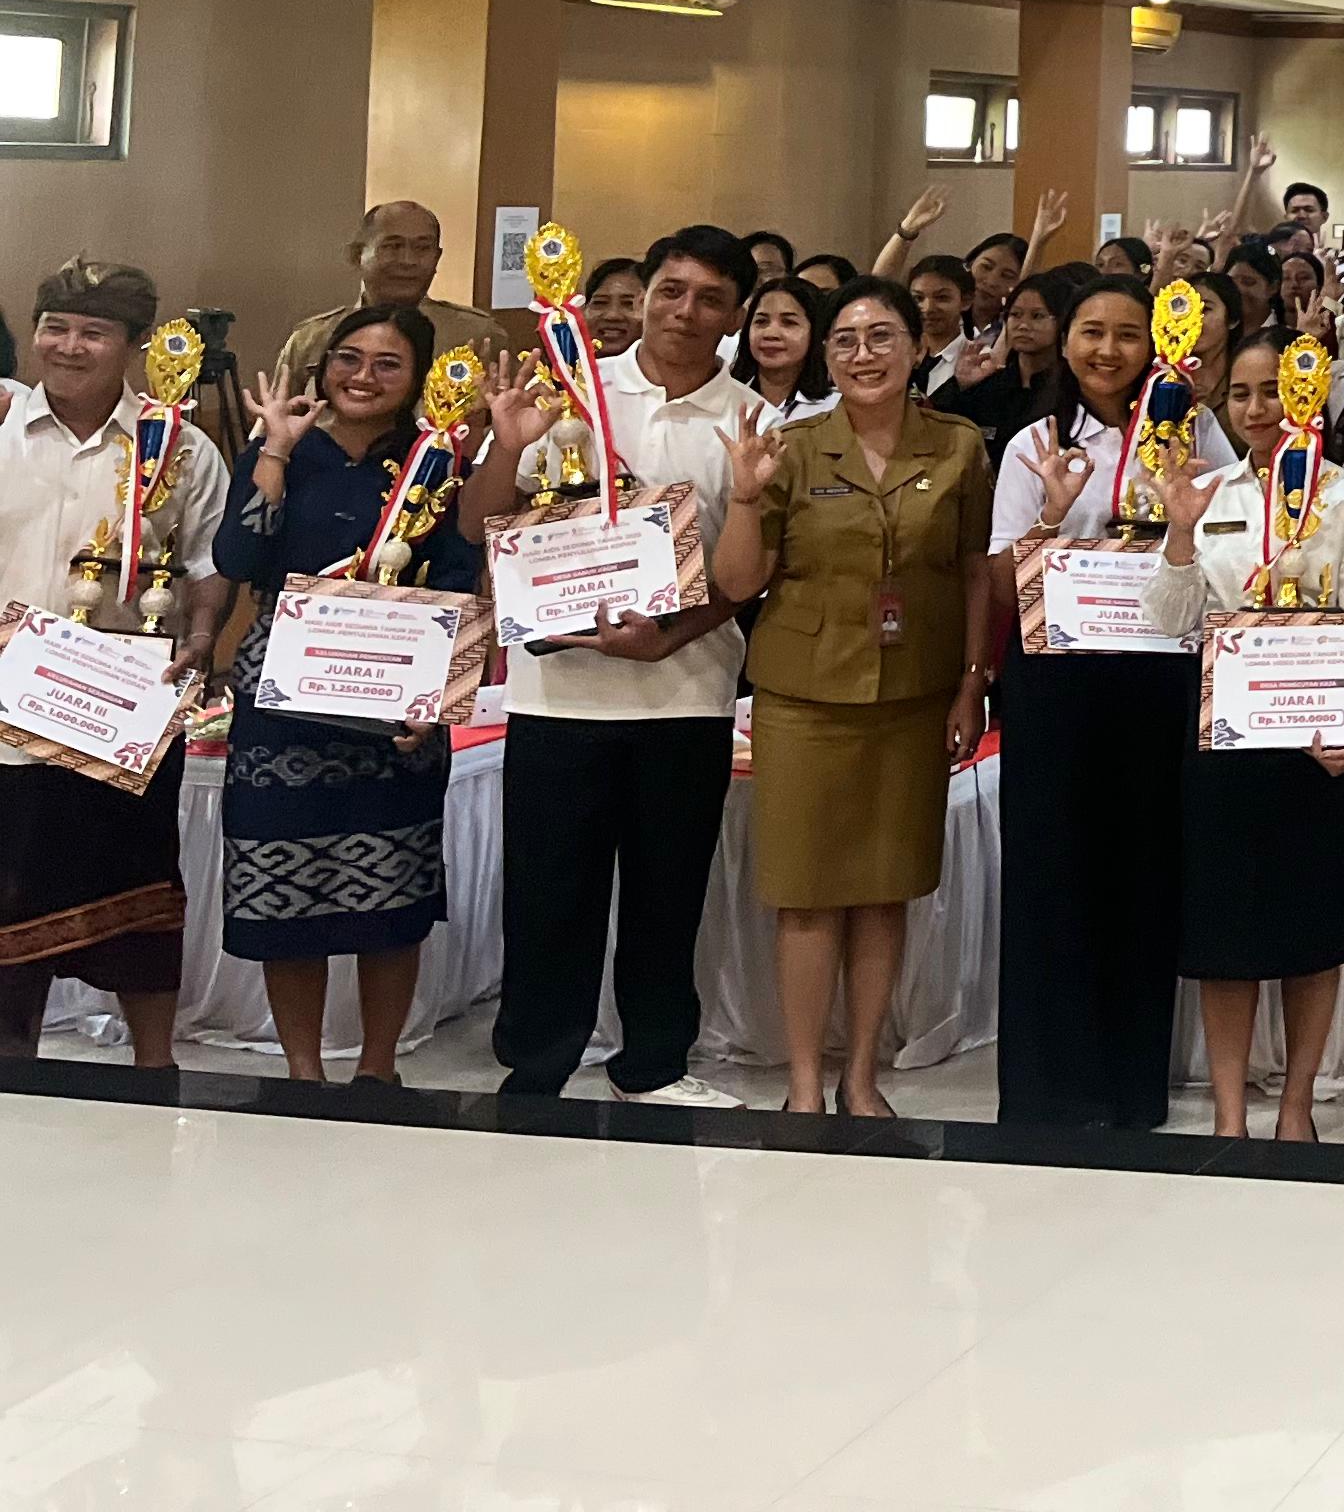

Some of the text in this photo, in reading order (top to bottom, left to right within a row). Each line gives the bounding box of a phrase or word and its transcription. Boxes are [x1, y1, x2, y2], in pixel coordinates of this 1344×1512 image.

[558, 580, 606, 597] JUARA
[546, 593, 630, 617] Rp. 1.500000
[1096, 610, 1138, 620] JUARA
[1088, 625, 1105, 633] Rp.
[324, 664, 385, 679] JUARA II
[308, 681, 394, 697] Rp. 1.250.0000
[26, 699, 47, 714] Rp.
[46, 687, 94, 712] JUARA
[93, 705, 108, 718] III
[1270, 694, 1326, 707] JUARA II
[1258, 713, 1337, 725] Rp. 1.750.0000
